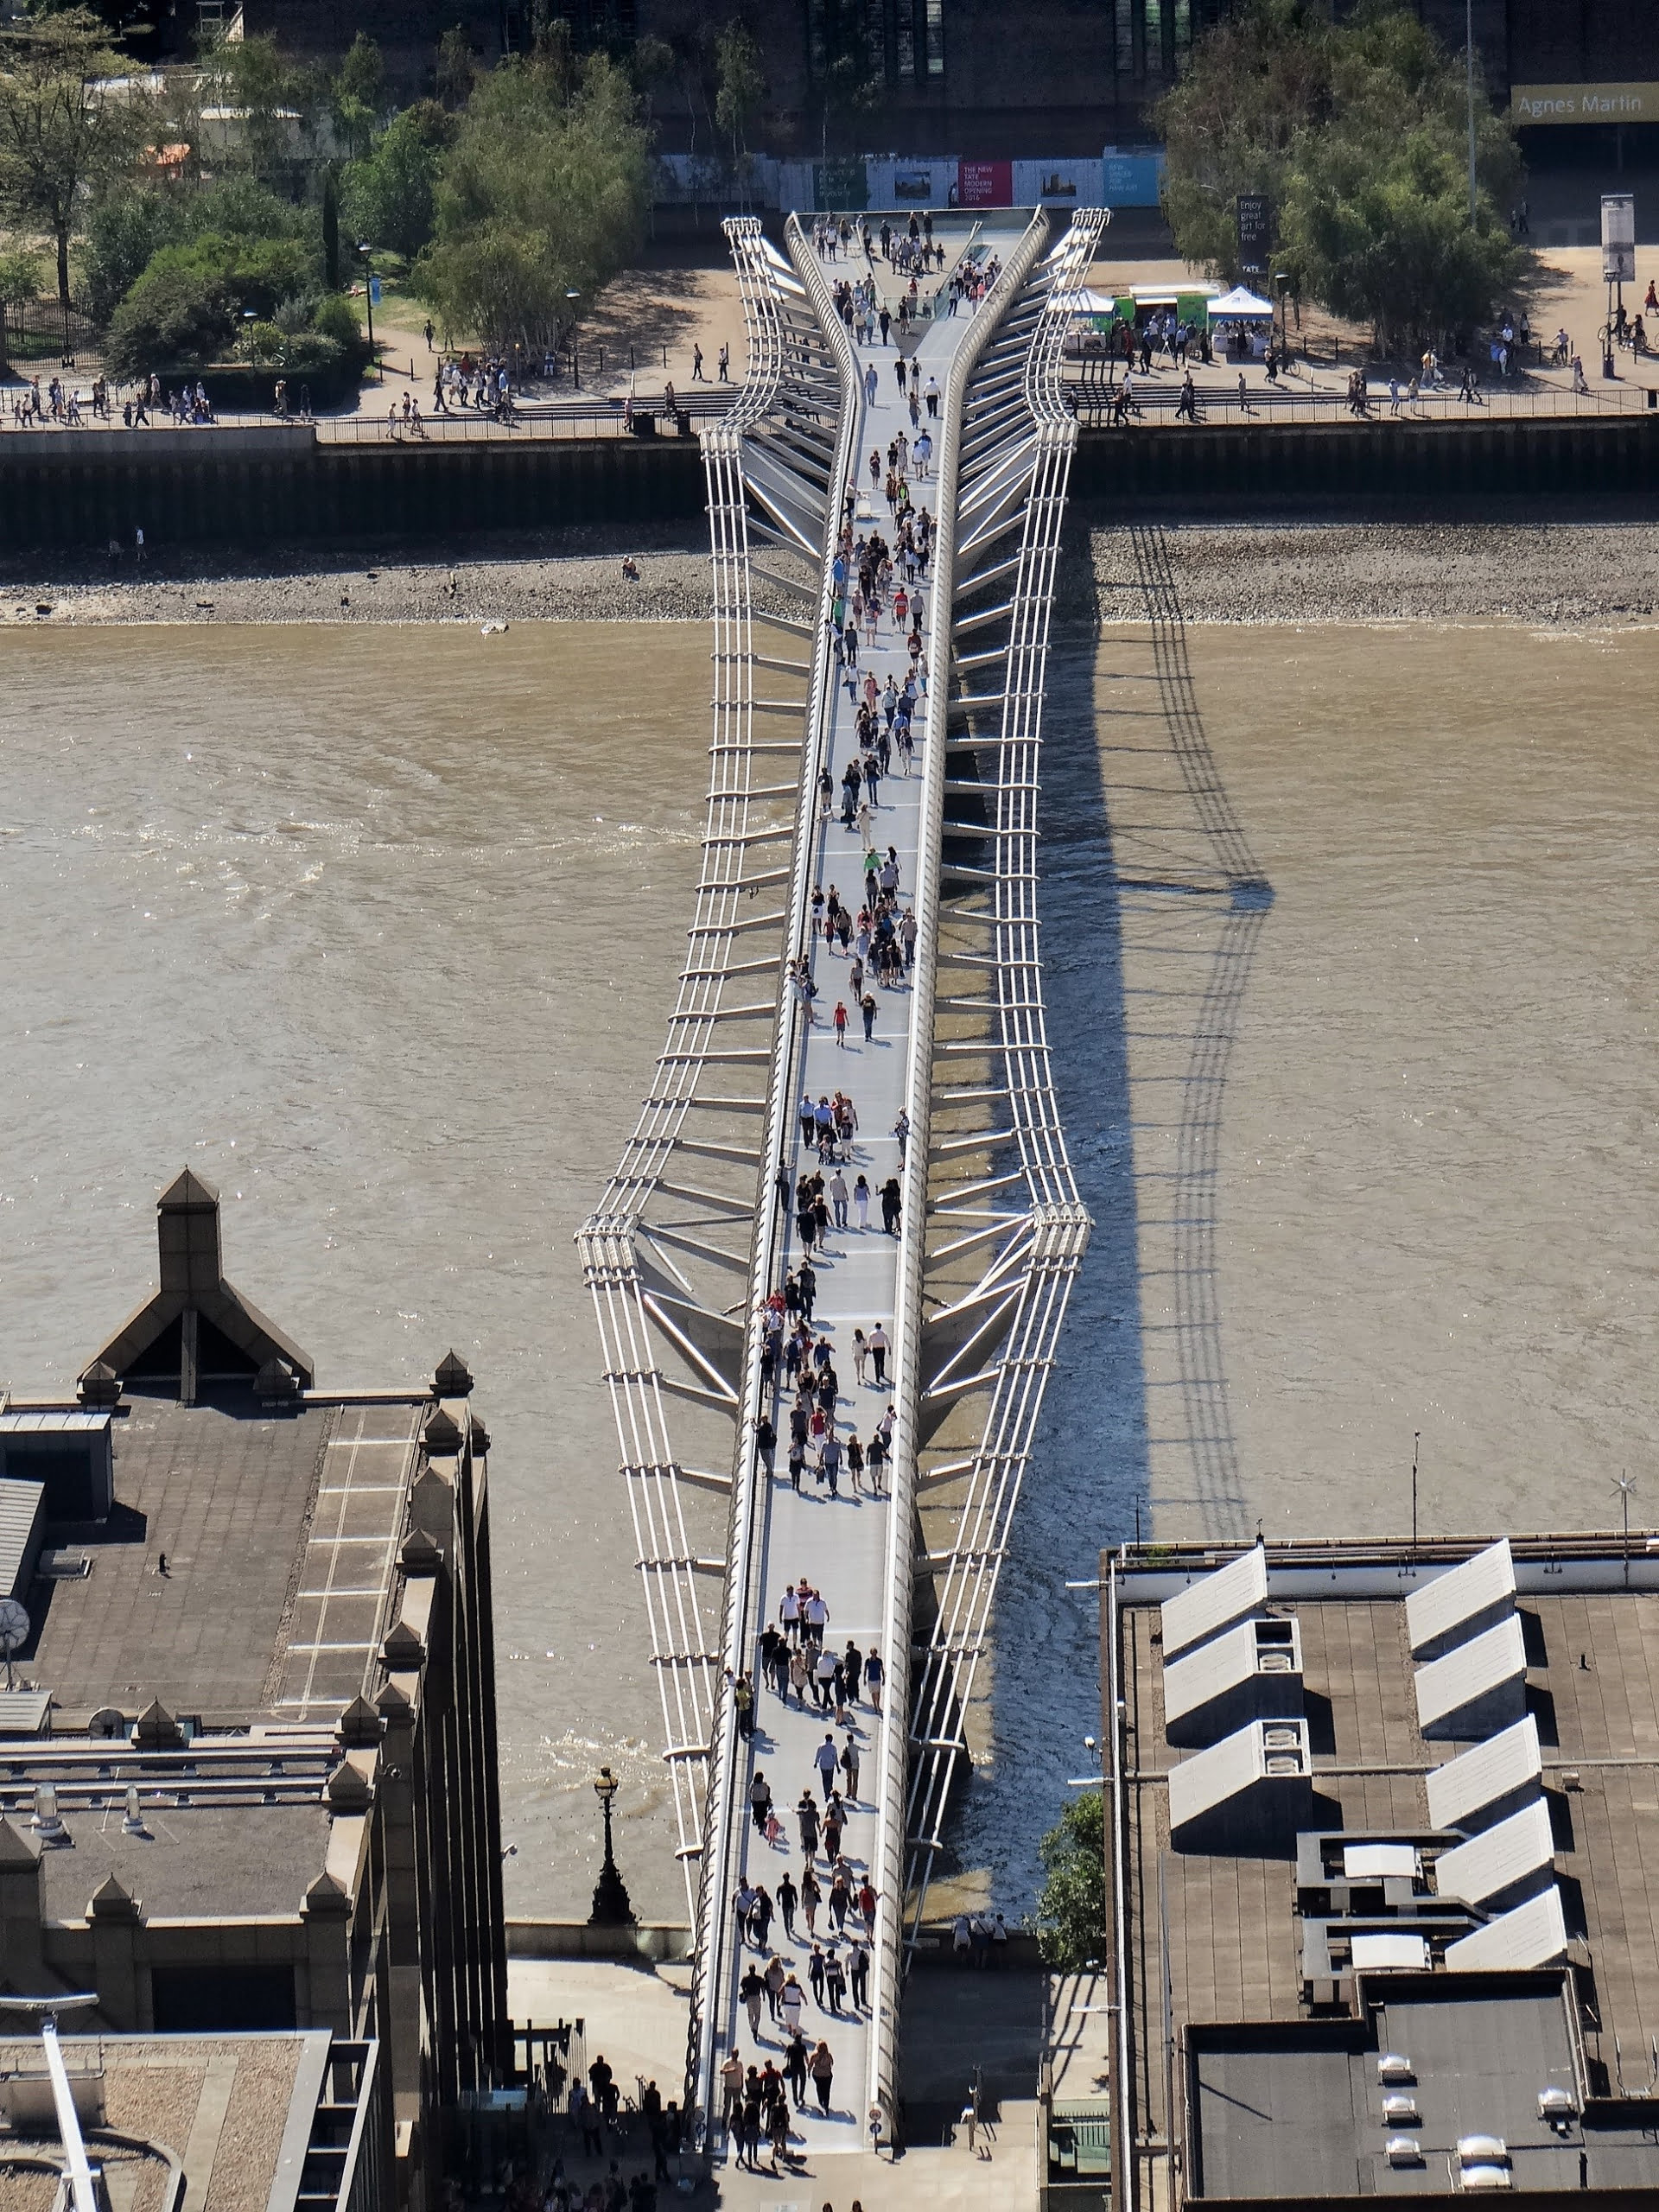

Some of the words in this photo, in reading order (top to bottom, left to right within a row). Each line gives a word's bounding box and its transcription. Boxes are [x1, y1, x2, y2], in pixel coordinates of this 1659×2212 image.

[1518, 97, 1575, 118] Agnes
[1582, 95, 1642, 113] Martin
[1240, 200, 1262, 211] Enjoy
[1241, 211, 1261, 222] great
[1241, 222, 1252, 232] art
[1255, 220, 1266, 230] for
[1241, 232, 1257, 241] free
